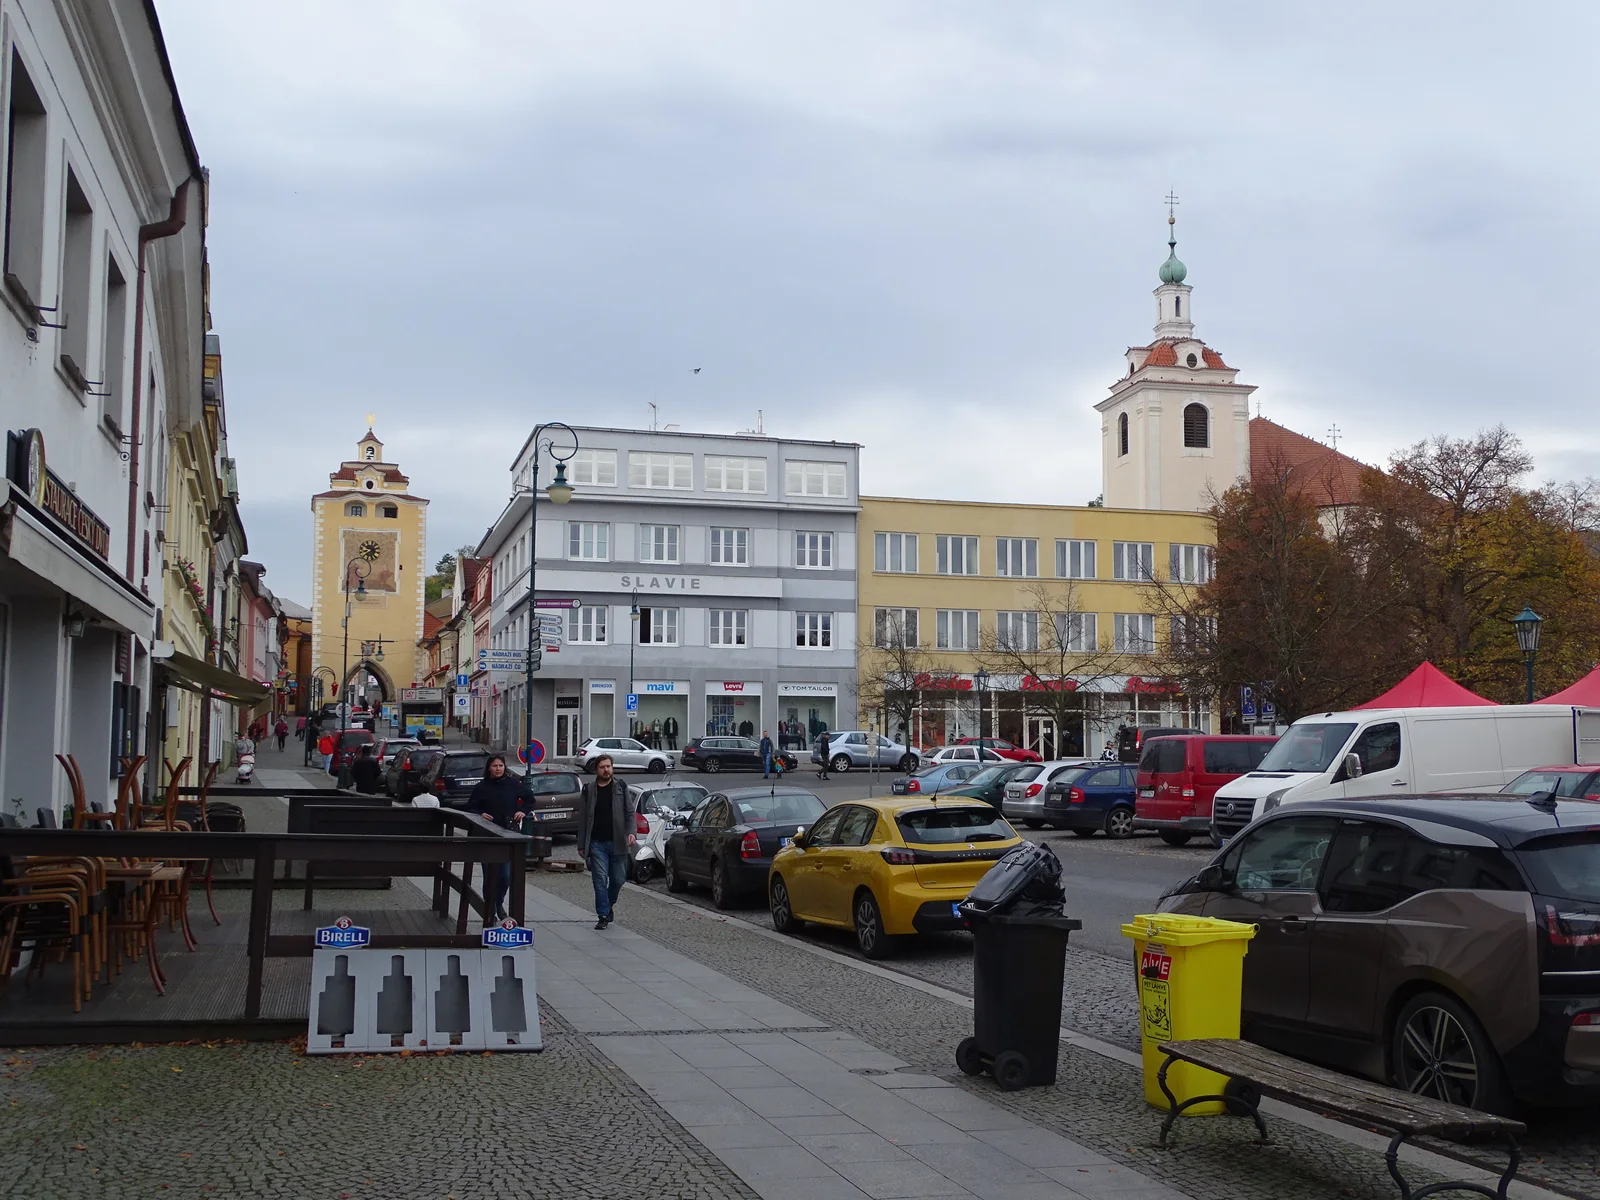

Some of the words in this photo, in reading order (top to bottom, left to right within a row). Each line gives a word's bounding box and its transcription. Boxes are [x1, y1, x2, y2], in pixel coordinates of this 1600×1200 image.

[43, 476, 77, 530] STAURACE
[77, 503, 96, 546] ČESKÝ
[620, 575, 702, 590] SLAVIE
[646, 682, 674, 692] mavi
[628, 695, 636, 705] P
[321, 931, 365, 943] BIRELL
[487, 931, 529, 944] BIRELL
[1141, 957, 1170, 976] AVE
